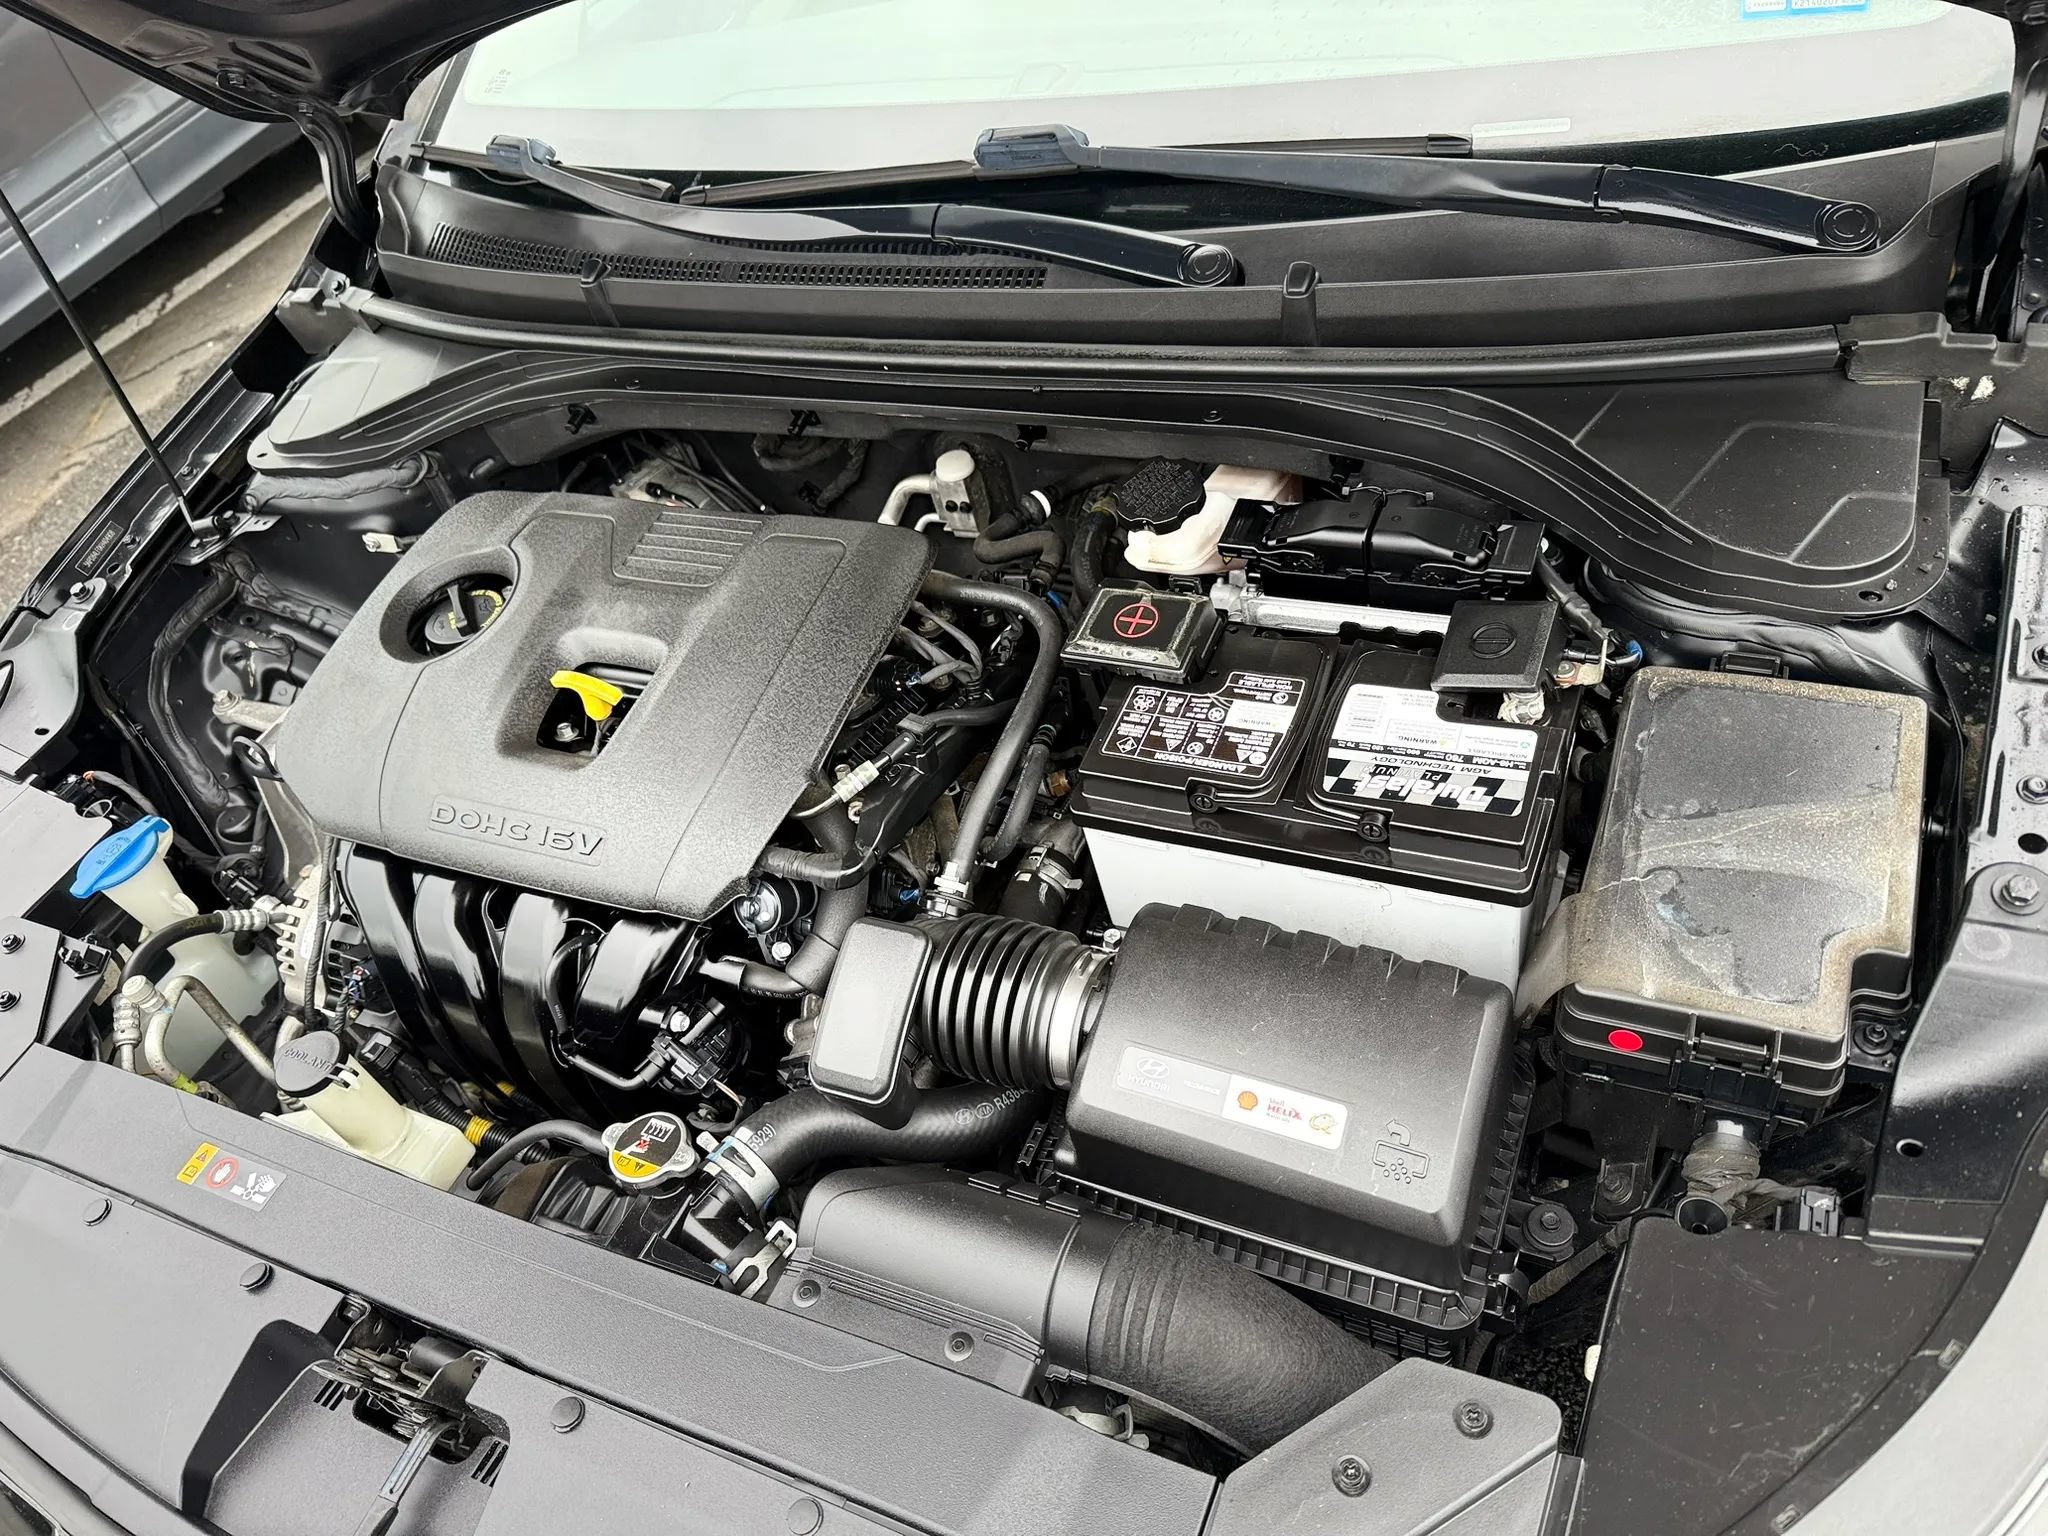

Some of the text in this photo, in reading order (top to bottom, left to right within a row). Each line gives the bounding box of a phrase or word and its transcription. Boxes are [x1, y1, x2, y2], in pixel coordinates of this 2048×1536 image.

[1397, 735, 1438, 746] WARNING
[1154, 752, 1238, 771] DANGER/POISON
[1370, 756, 1457, 774] TECHNOLOGY
[1361, 764, 1443, 782] PLATINUM
[1459, 766, 1493, 776] AGM
[1352, 773, 1489, 806] Duralast
[431, 801, 604, 856] DOHC 16V
[284, 1048, 333, 1073] COOLANT
[1127, 1072, 1171, 1093] HYUNDAI
[1266, 1103, 1303, 1121] HELIX
